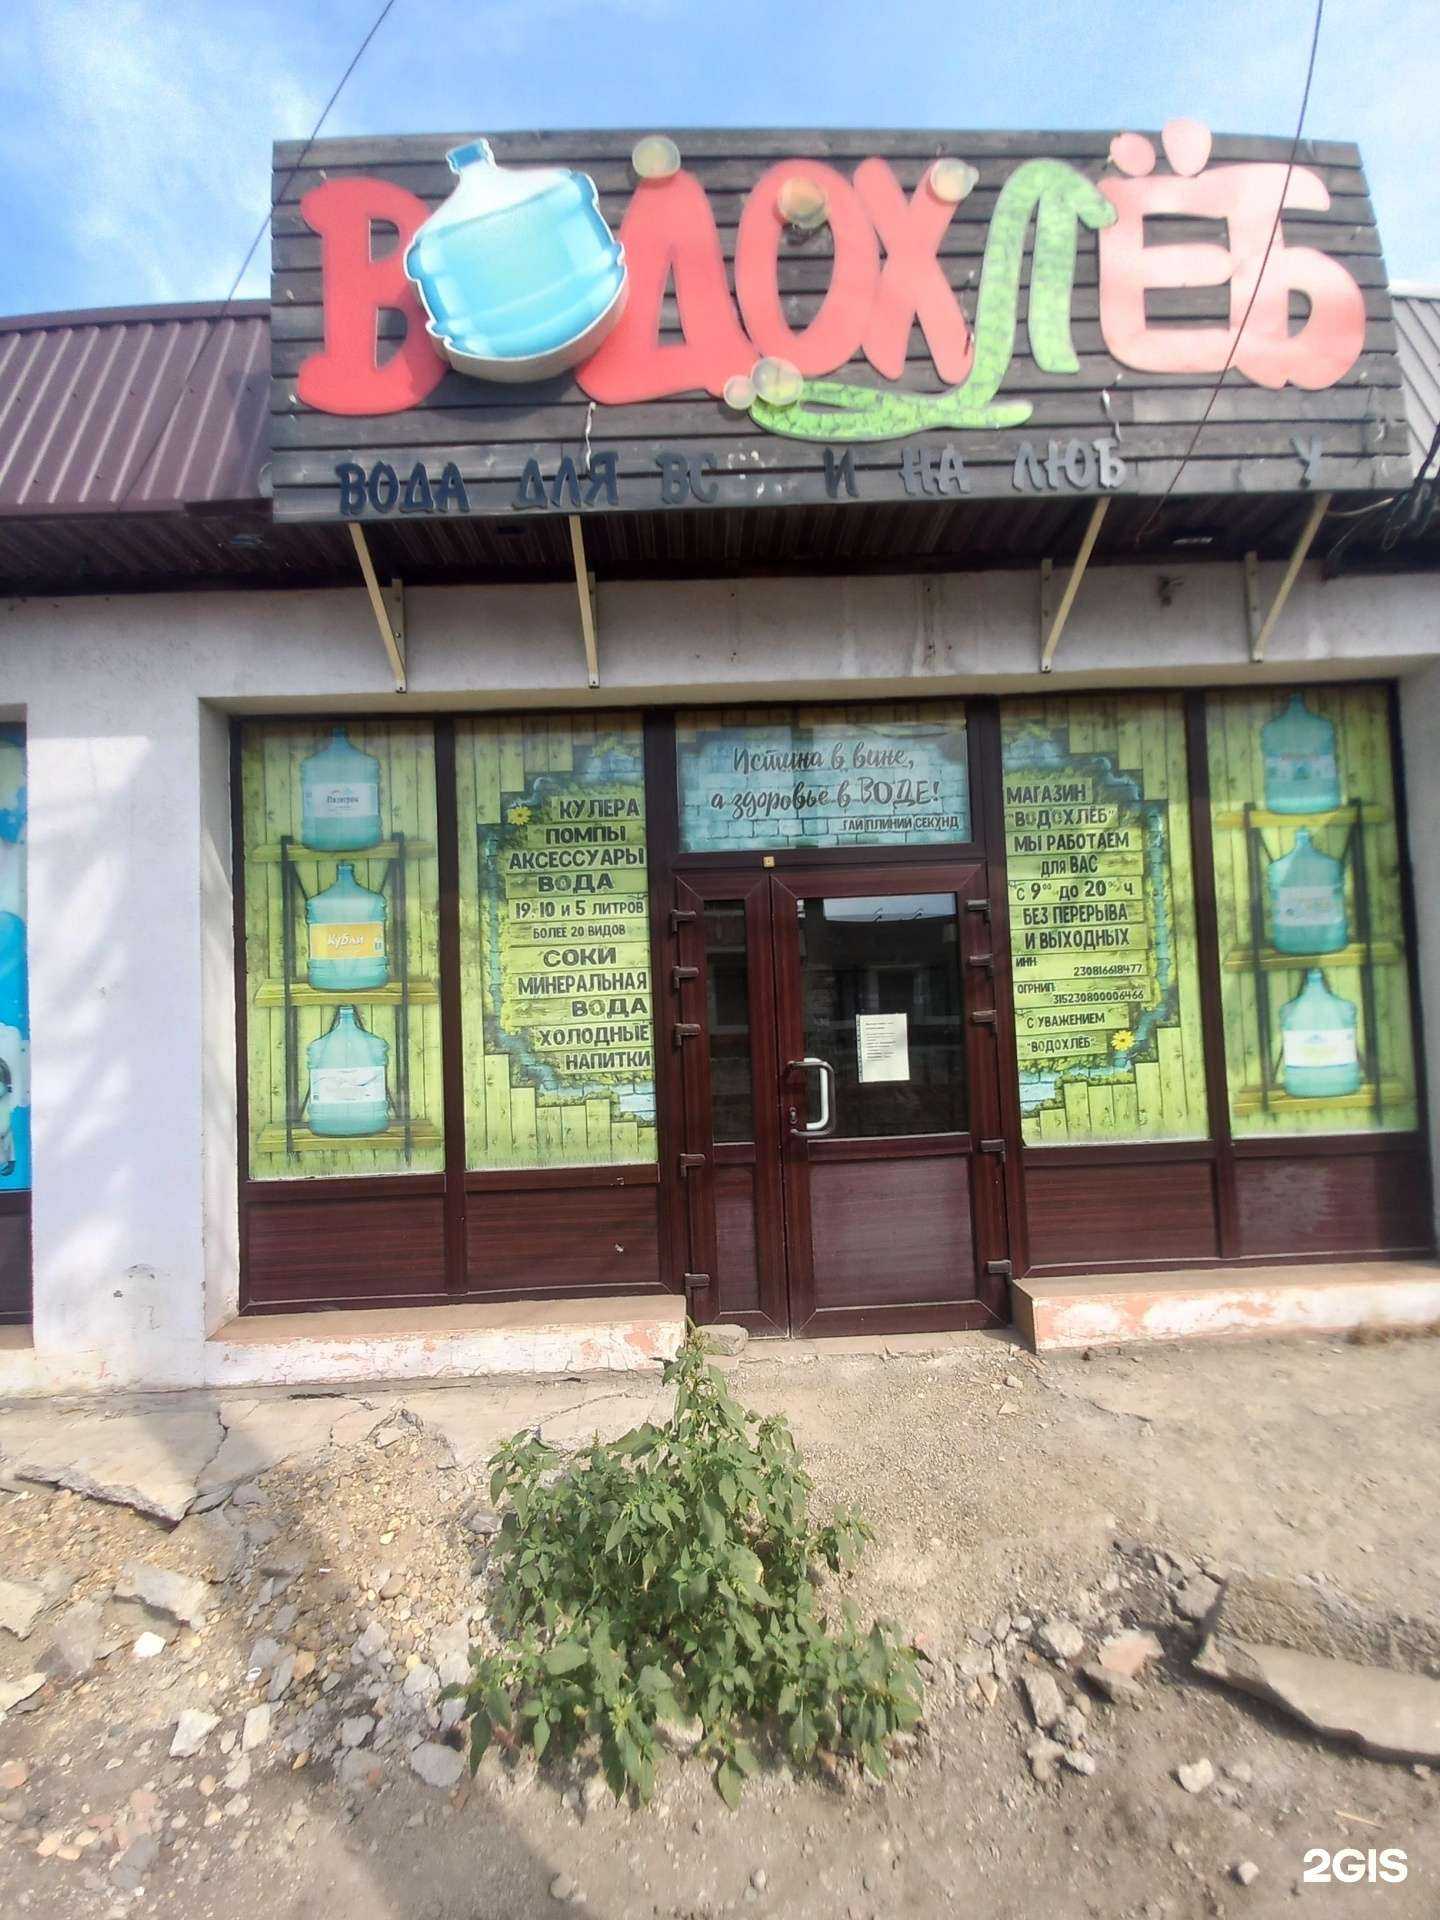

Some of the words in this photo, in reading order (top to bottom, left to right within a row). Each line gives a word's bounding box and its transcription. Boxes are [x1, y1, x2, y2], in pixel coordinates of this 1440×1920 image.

[297, 118, 1366, 442] ВДОХЛЁБ
[335, 459, 471, 515] ВОДА
[513, 451, 619, 509] ДЛЯ
[823, 446, 859, 498] И
[898, 442, 971, 497] НА
[1288, 433, 1321, 488] У
[733, 746, 824, 774] Истина
[831, 742, 846, 770] в
[853, 741, 914, 770] вине,
[711, 793, 725, 809] а
[732, 781, 829, 818] здоровье
[838, 780, 851, 807] в
[856, 776, 940, 811] ВОДЕ!
[1006, 784, 1086, 804] МАГАЗИН
[559, 798, 640, 819] КУЛЕРА
[915, 816, 960, 829] СЕКУНД
[546, 825, 626, 844] ПОМПЫ
[1014, 835, 1042, 851] МЫ
[1046, 832, 1129, 850] РАБОТАЕМ
[509, 847, 644, 869] АКСЕССУАРЫ
[1070, 855, 1098, 873] ВАС
[538, 872, 614, 893] ВОДА
[539, 901, 555, 918] 10
[575, 900, 586, 915] 5
[592, 901, 644, 916] ЛИТРОВ
[1023, 908, 1048, 925] БЕЗ
[1053, 903, 1128, 924] ПЕРЕРЫВА
[533, 926, 567, 940] БОЛЕЕ
[571, 926, 585, 938] 20
[588, 924, 626, 938] ВИДОВ
[1025, 932, 1036, 949] И
[1039, 928, 1129, 949] ВЫХОДНЫХ
[543, 947, 617, 967] СОКИ
[1073, 964, 1142, 976] 230816618477
[518, 972, 647, 995] МИНЕРАЛЬНАЯ
[1053, 991, 1144, 1004] 315230800006466
[572, 998, 648, 1018] ВОДА
[1026, 1018, 1034, 1029] С
[1037, 1013, 1105, 1028] УВАЖЕНИЕМ
[540, 1025, 650, 1046] ХОЛОДНЫЕ
[565, 1051, 651, 1070] НАПИТКИ
